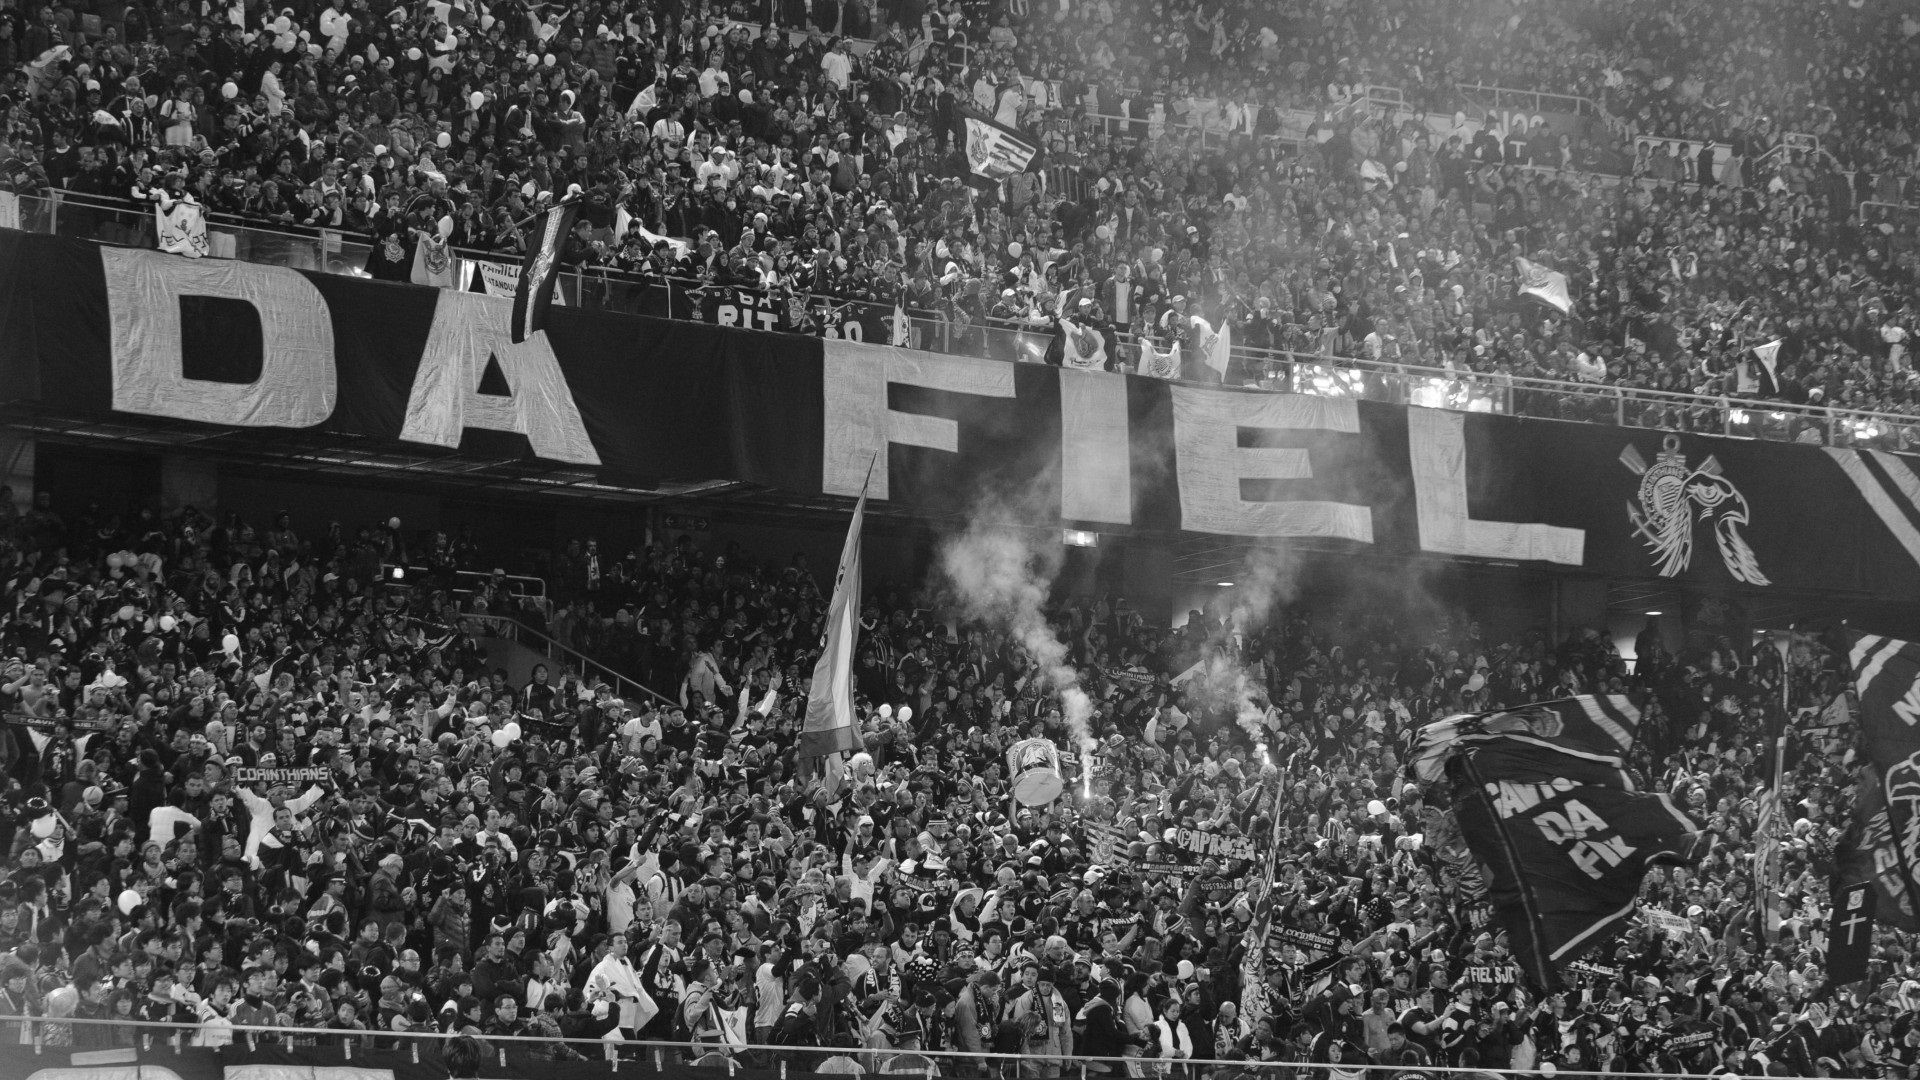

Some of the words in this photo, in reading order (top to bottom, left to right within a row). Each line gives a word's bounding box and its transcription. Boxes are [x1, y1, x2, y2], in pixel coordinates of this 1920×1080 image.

[100, 246, 602, 466] DA
[822, 338, 1585, 567] FIEL
[237, 766, 329, 782] CORINTHIANS
[1532, 799, 1610, 846] DA
[1285, 928, 1335, 946] corinthians
[1470, 966, 1493, 983] FIEL
